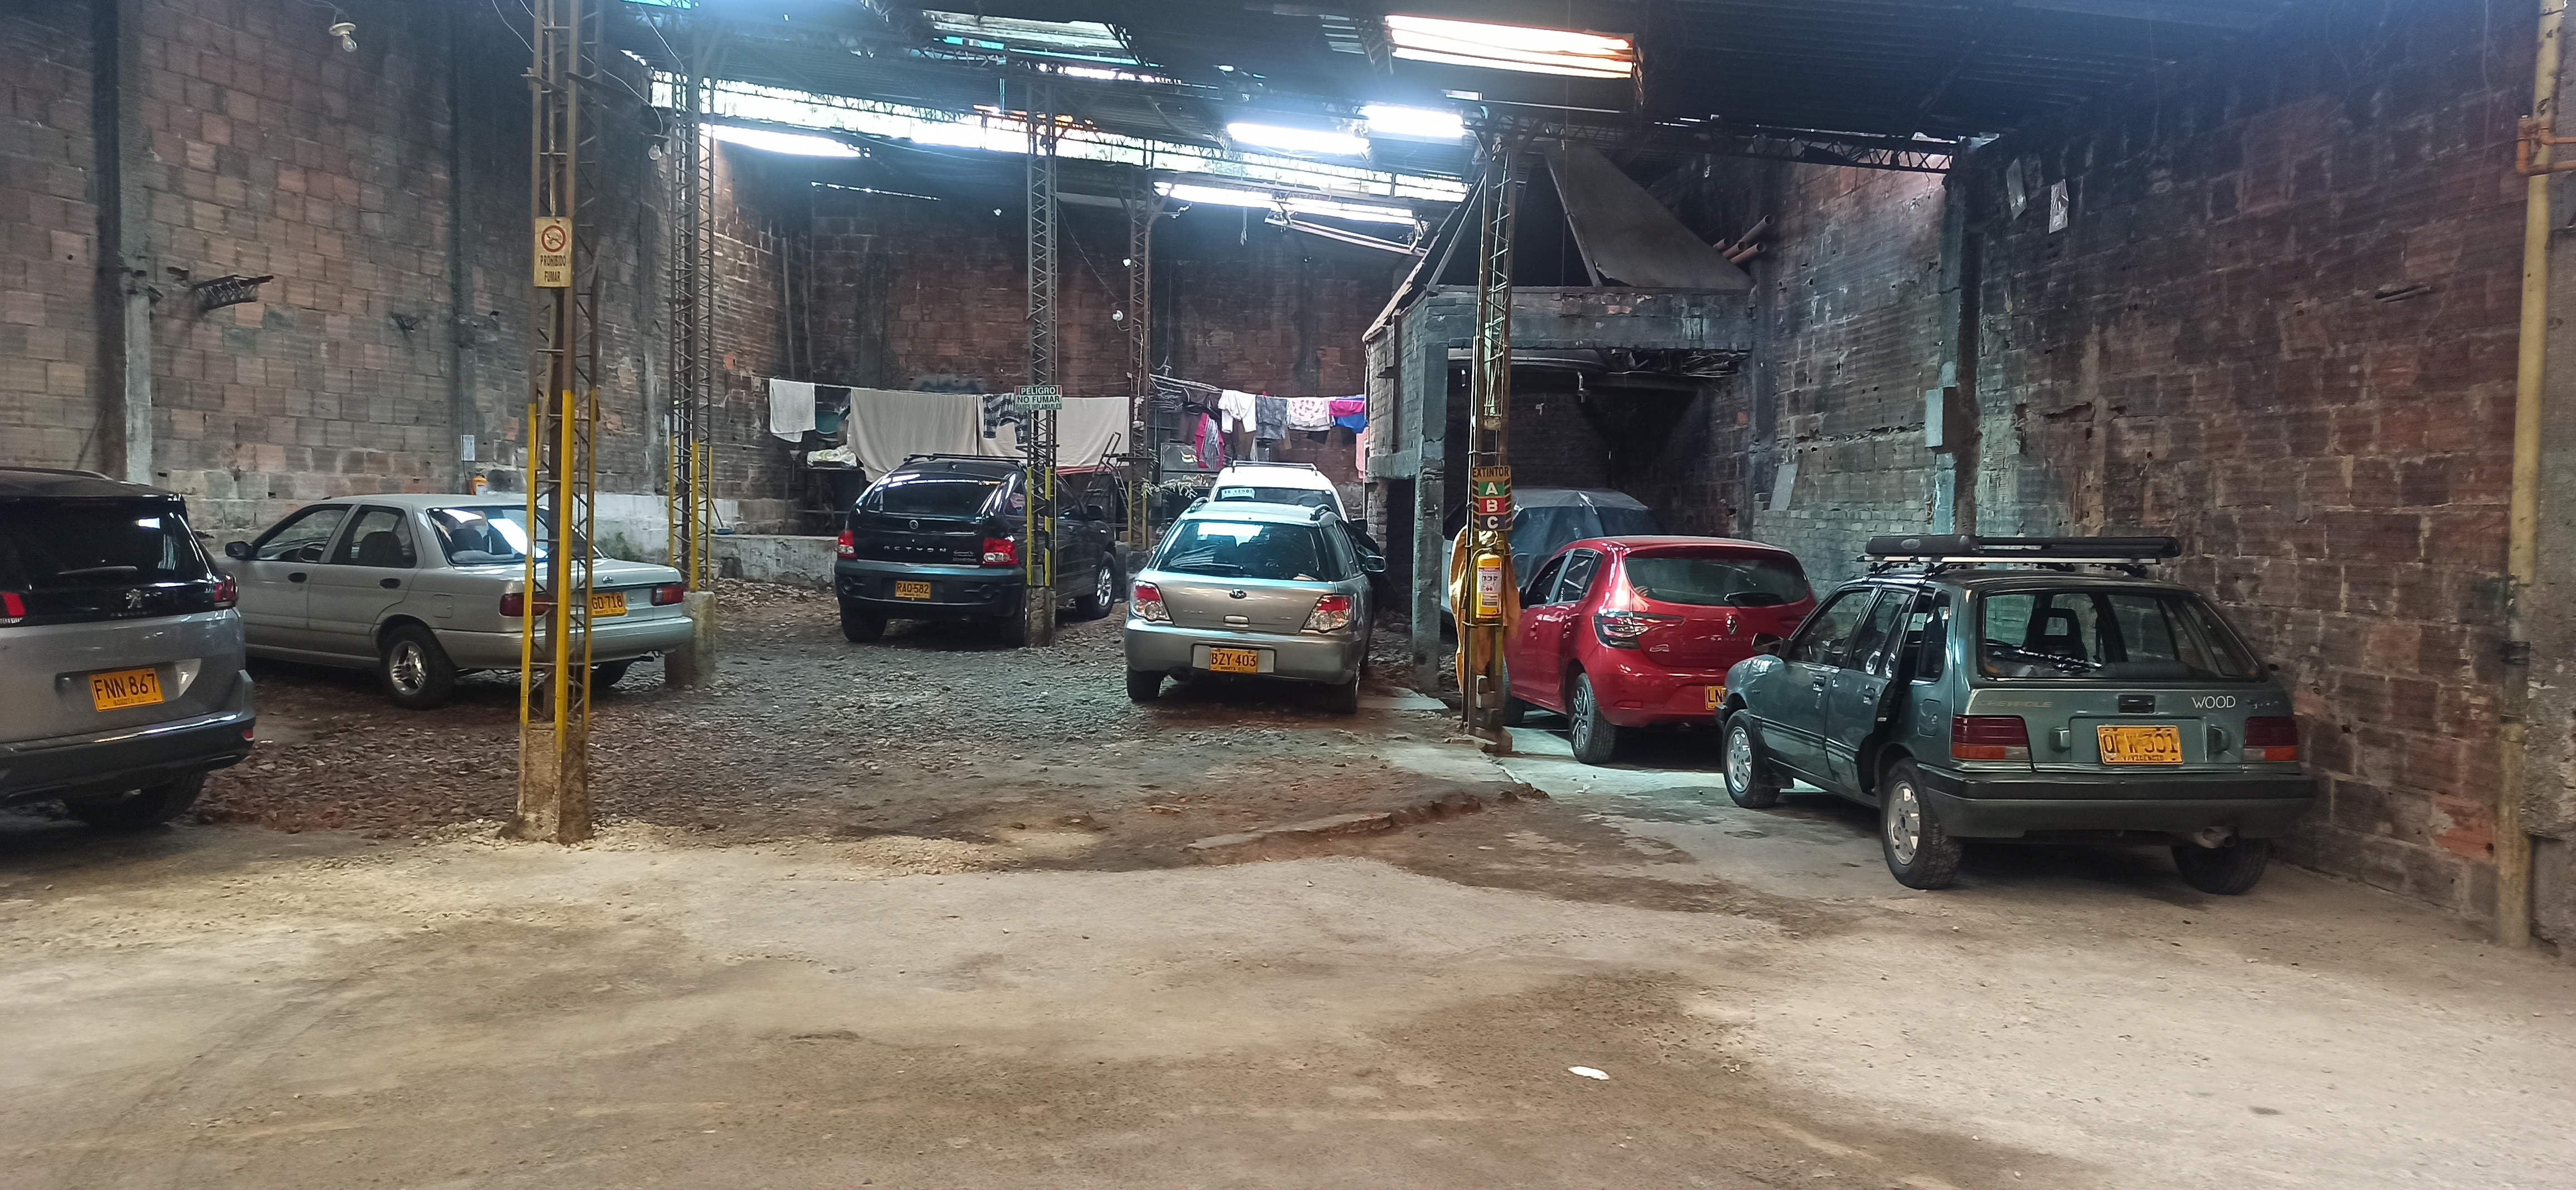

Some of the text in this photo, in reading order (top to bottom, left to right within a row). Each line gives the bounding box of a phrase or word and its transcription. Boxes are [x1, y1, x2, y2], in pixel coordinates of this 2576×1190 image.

[539, 255, 566, 266] PROHIBIDO
[544, 271, 560, 282] FUMAR
[1021, 387, 1056, 395] PELIGRO
[1472, 466, 1509, 477] EXTINTOR
[1485, 482, 1498, 495] A
[1486, 499, 1498, 512] B
[1487, 516, 1499, 529] C
[94, 673, 157, 700] FNN 867
[2191, 696, 2236, 709] WOOD
